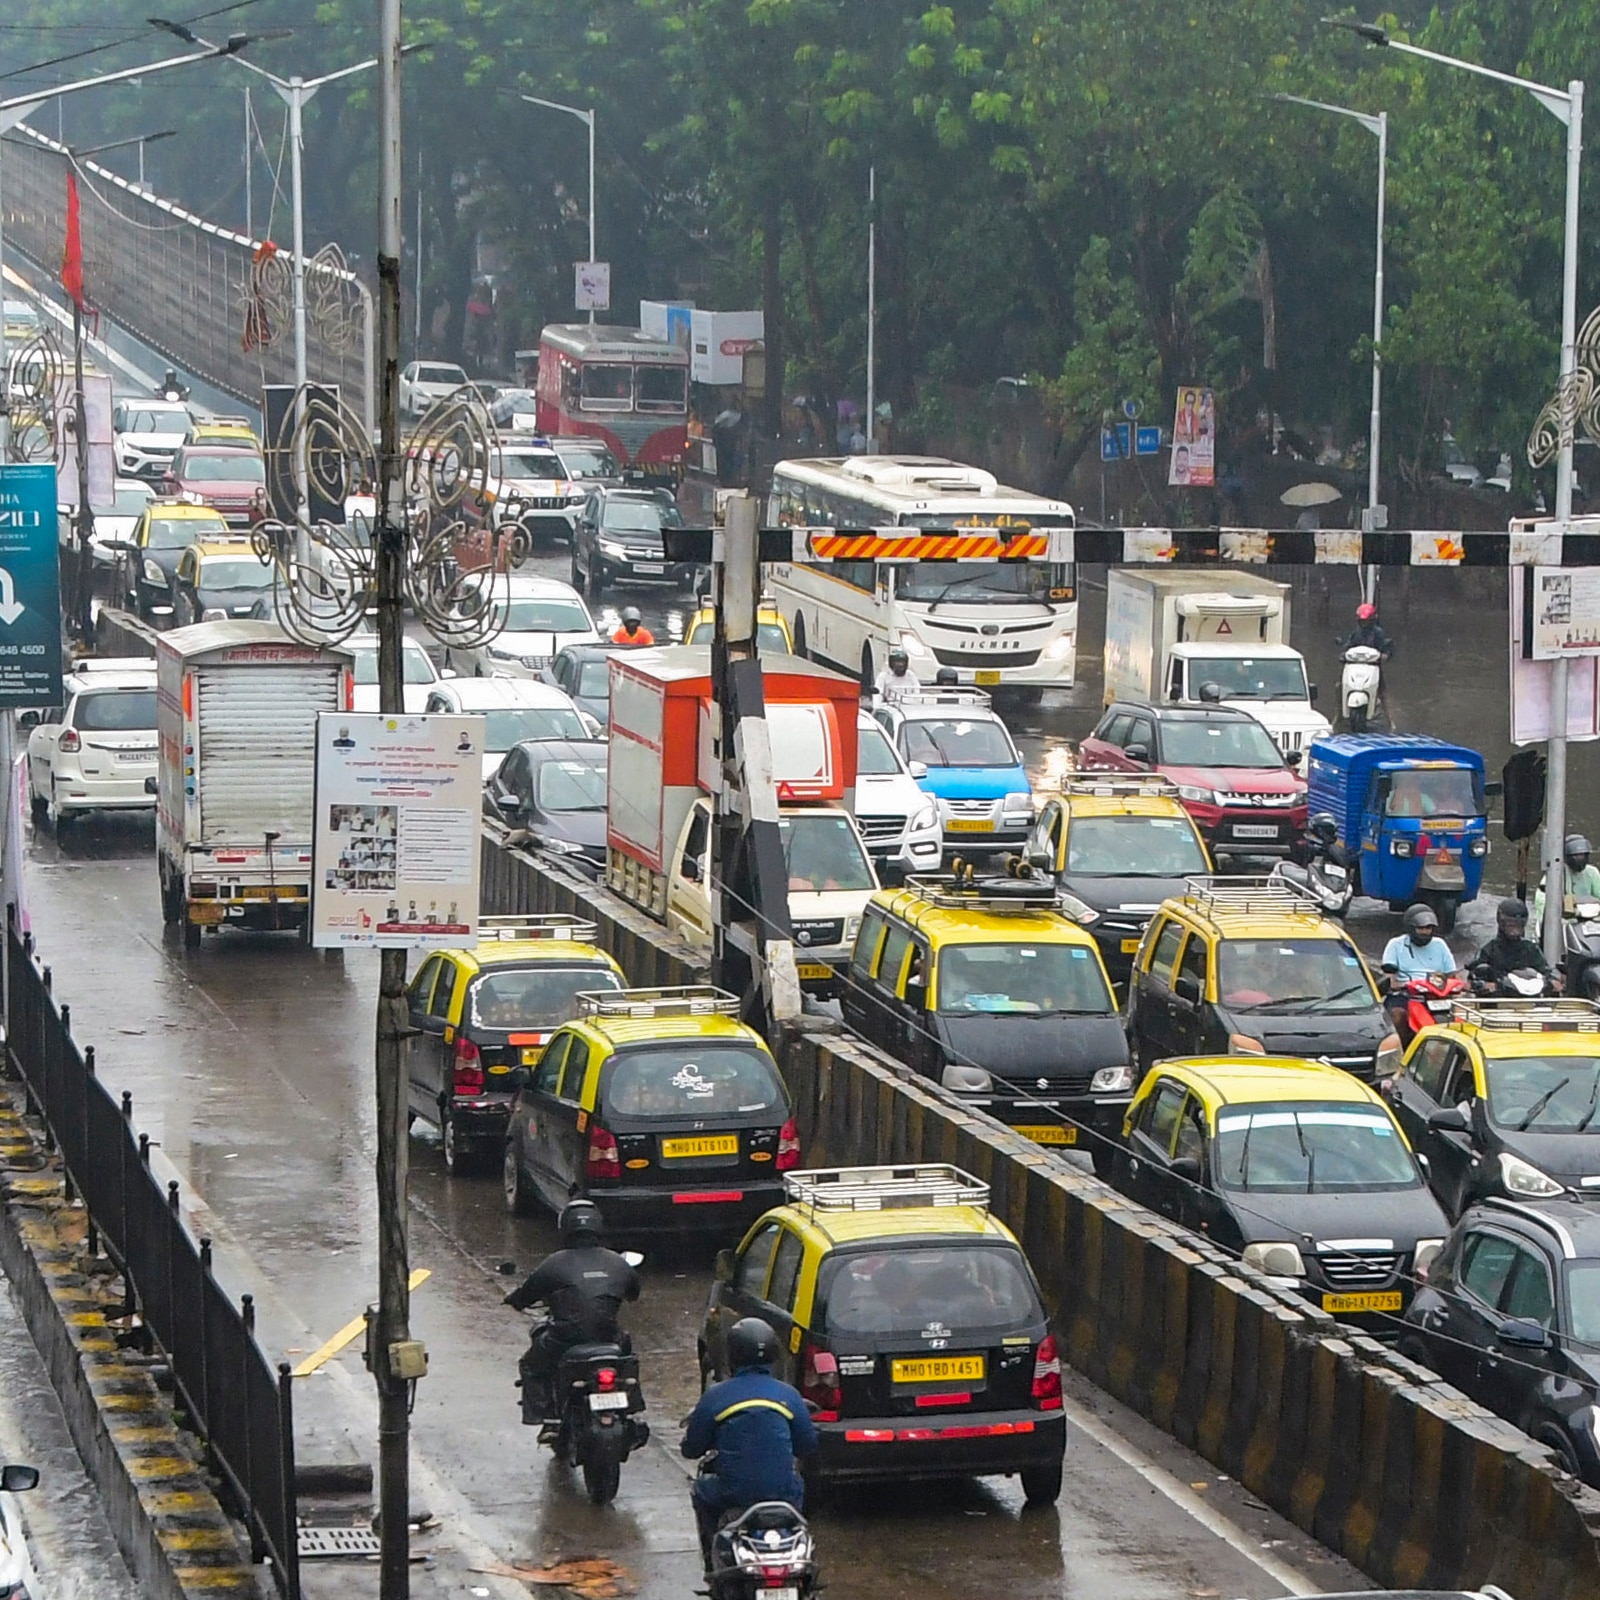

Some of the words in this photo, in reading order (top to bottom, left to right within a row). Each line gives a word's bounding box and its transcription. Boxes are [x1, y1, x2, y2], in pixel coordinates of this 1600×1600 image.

[20, 645, 45, 655] 4500
[960, 641, 1020, 649] EICHER
[671, 1139, 735, 1153] MH01AT6101
[902, 1361, 981, 1376] MH01BD1451
